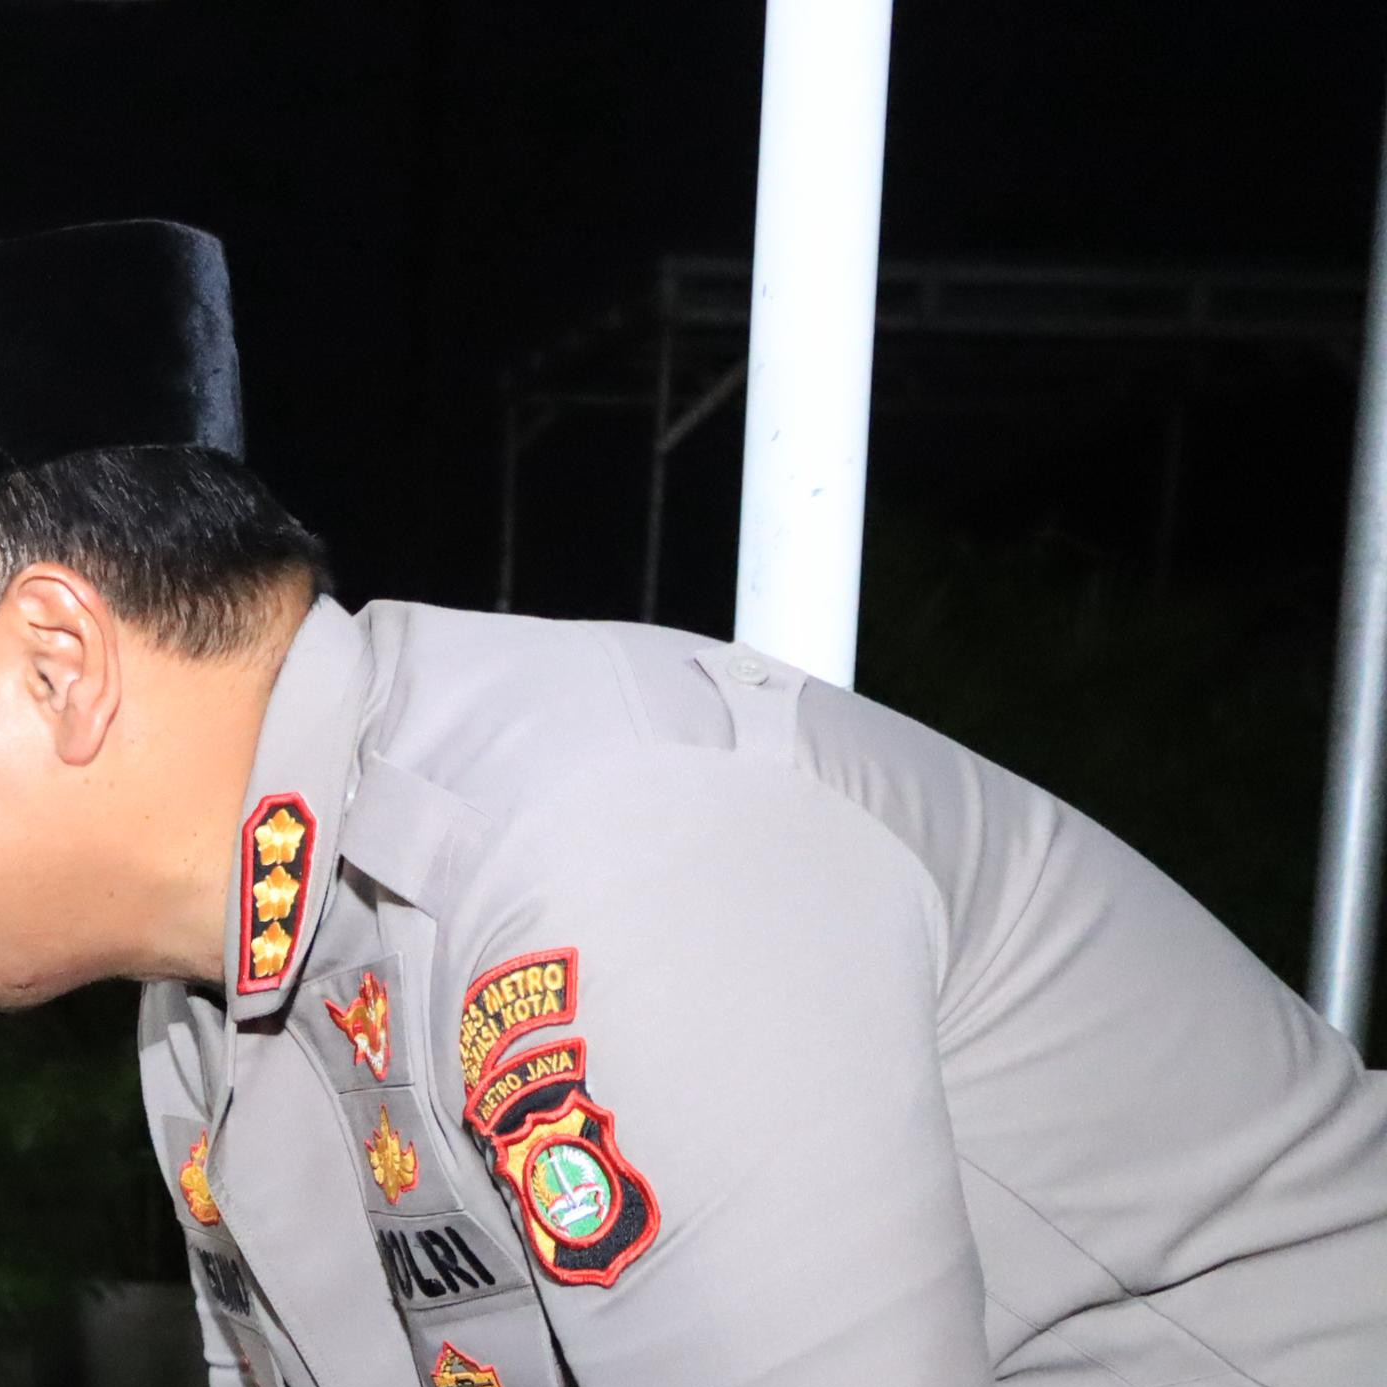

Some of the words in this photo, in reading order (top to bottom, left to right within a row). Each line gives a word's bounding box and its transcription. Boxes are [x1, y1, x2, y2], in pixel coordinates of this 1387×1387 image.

[483, 963, 565, 1015] METRO
[502, 993, 560, 1030] KOTA
[479, 1073, 522, 1120] METRO
[527, 1050, 573, 1083] JAYA
